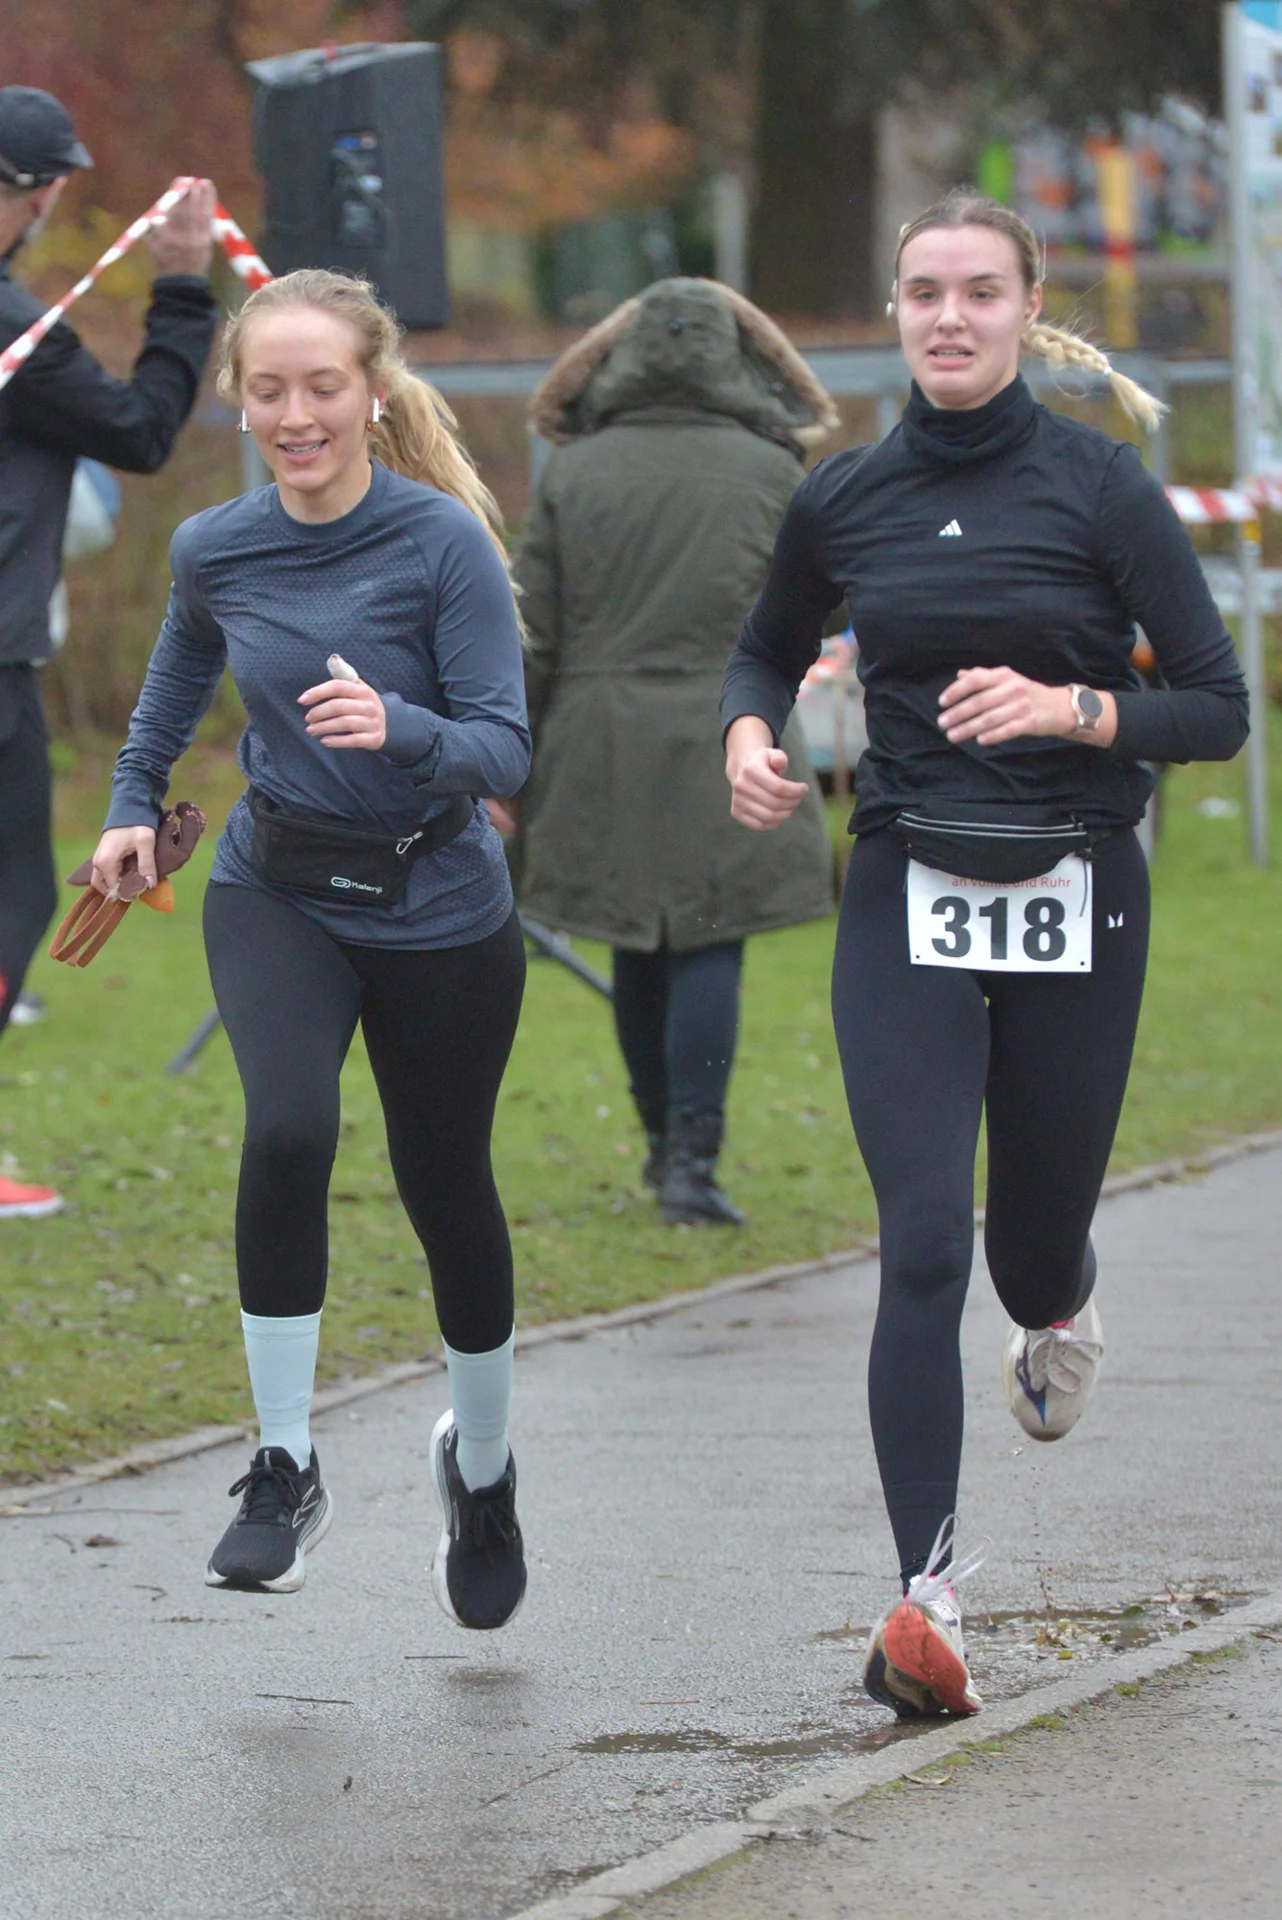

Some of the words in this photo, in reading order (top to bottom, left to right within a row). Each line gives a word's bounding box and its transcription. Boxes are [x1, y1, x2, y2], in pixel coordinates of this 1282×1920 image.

[951, 878, 967, 888] an
[1041, 876, 1072, 888] Ruhr
[930, 895, 1067, 962] 318
